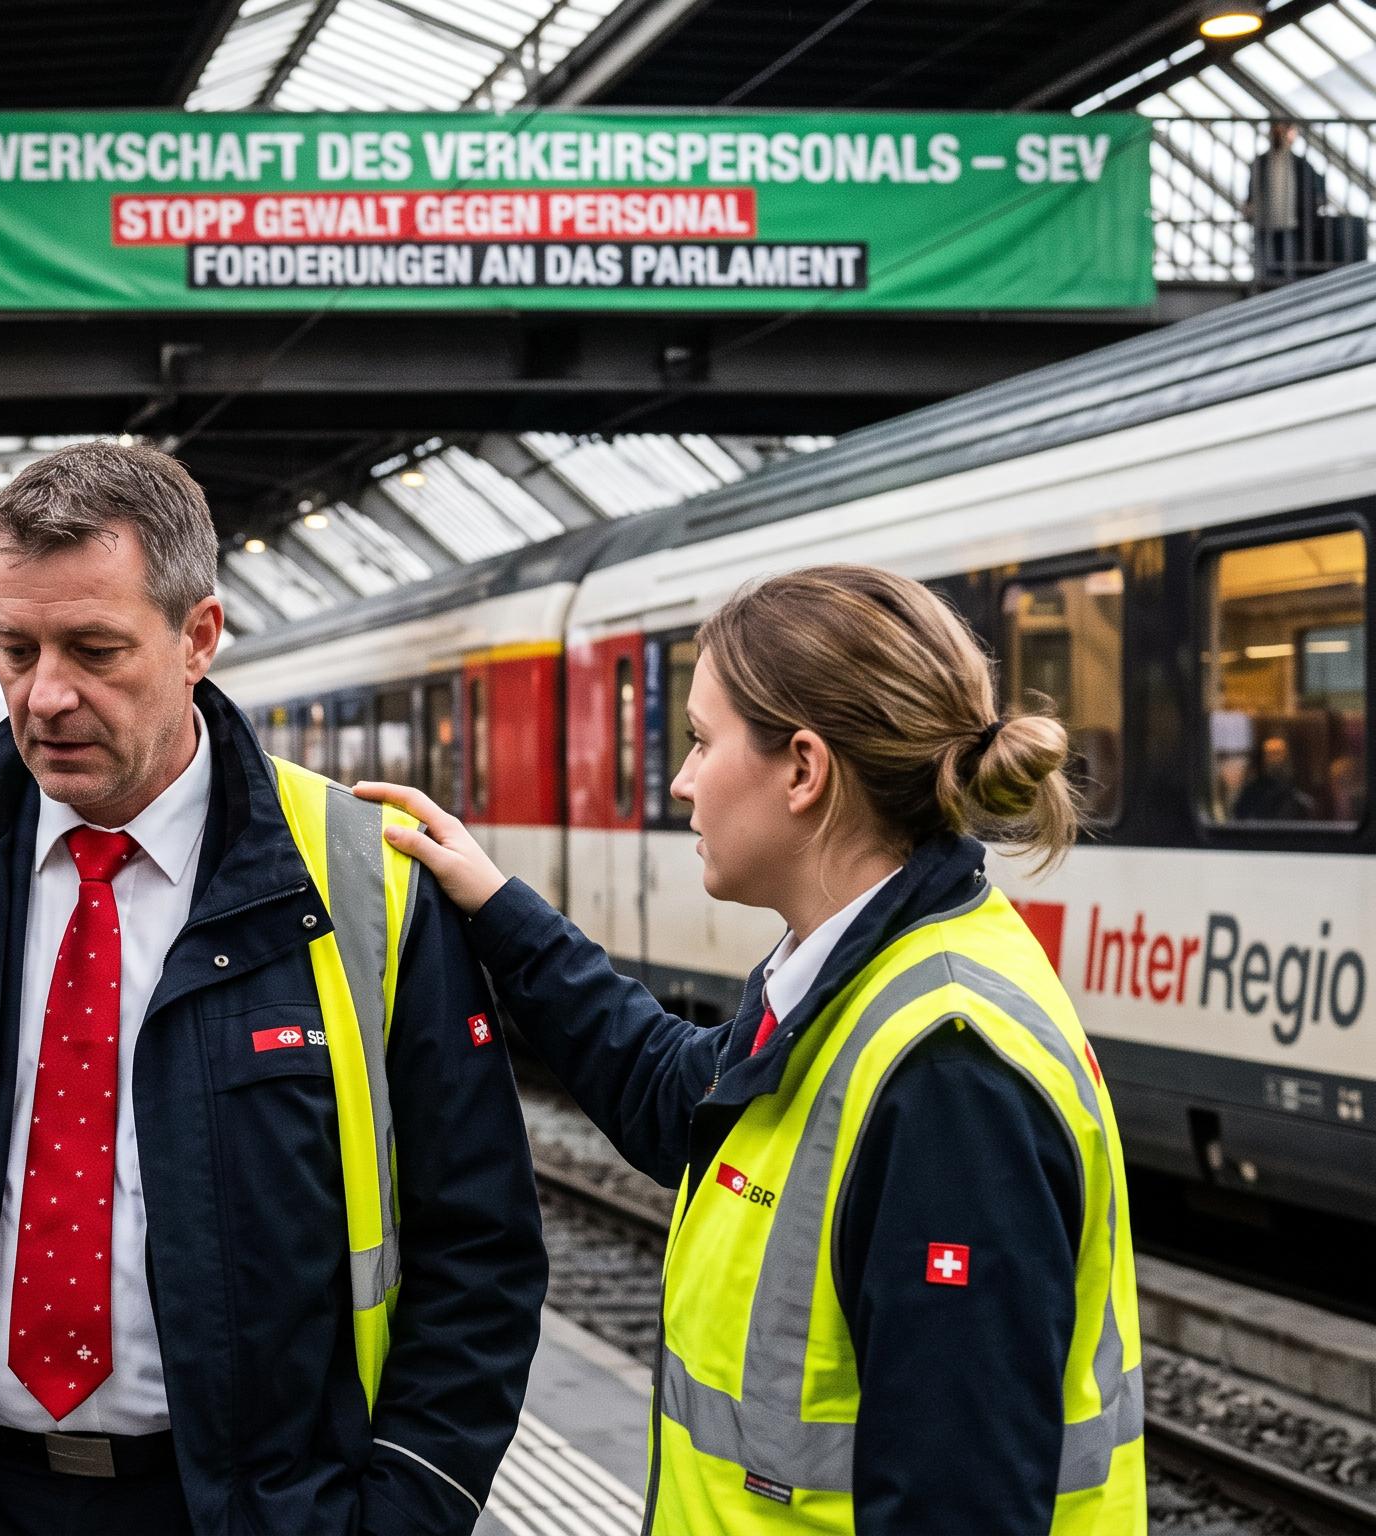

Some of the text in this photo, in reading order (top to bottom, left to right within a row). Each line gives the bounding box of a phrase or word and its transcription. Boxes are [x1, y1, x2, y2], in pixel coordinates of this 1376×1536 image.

[318, 133, 413, 181] DES
[423, 132, 960, 182] VERKEHRSPERSONALS
[1018, 135, 1108, 182] SEV
[120, 194, 750, 239] STOPP GEWALT GEGEN PERSONAL
[194, 245, 861, 286] FORDERUNGEN AN DAS PARLAMENT
[1084, 903, 1367, 1046] InterRegio
[306, 1030, 328, 1046] SB
